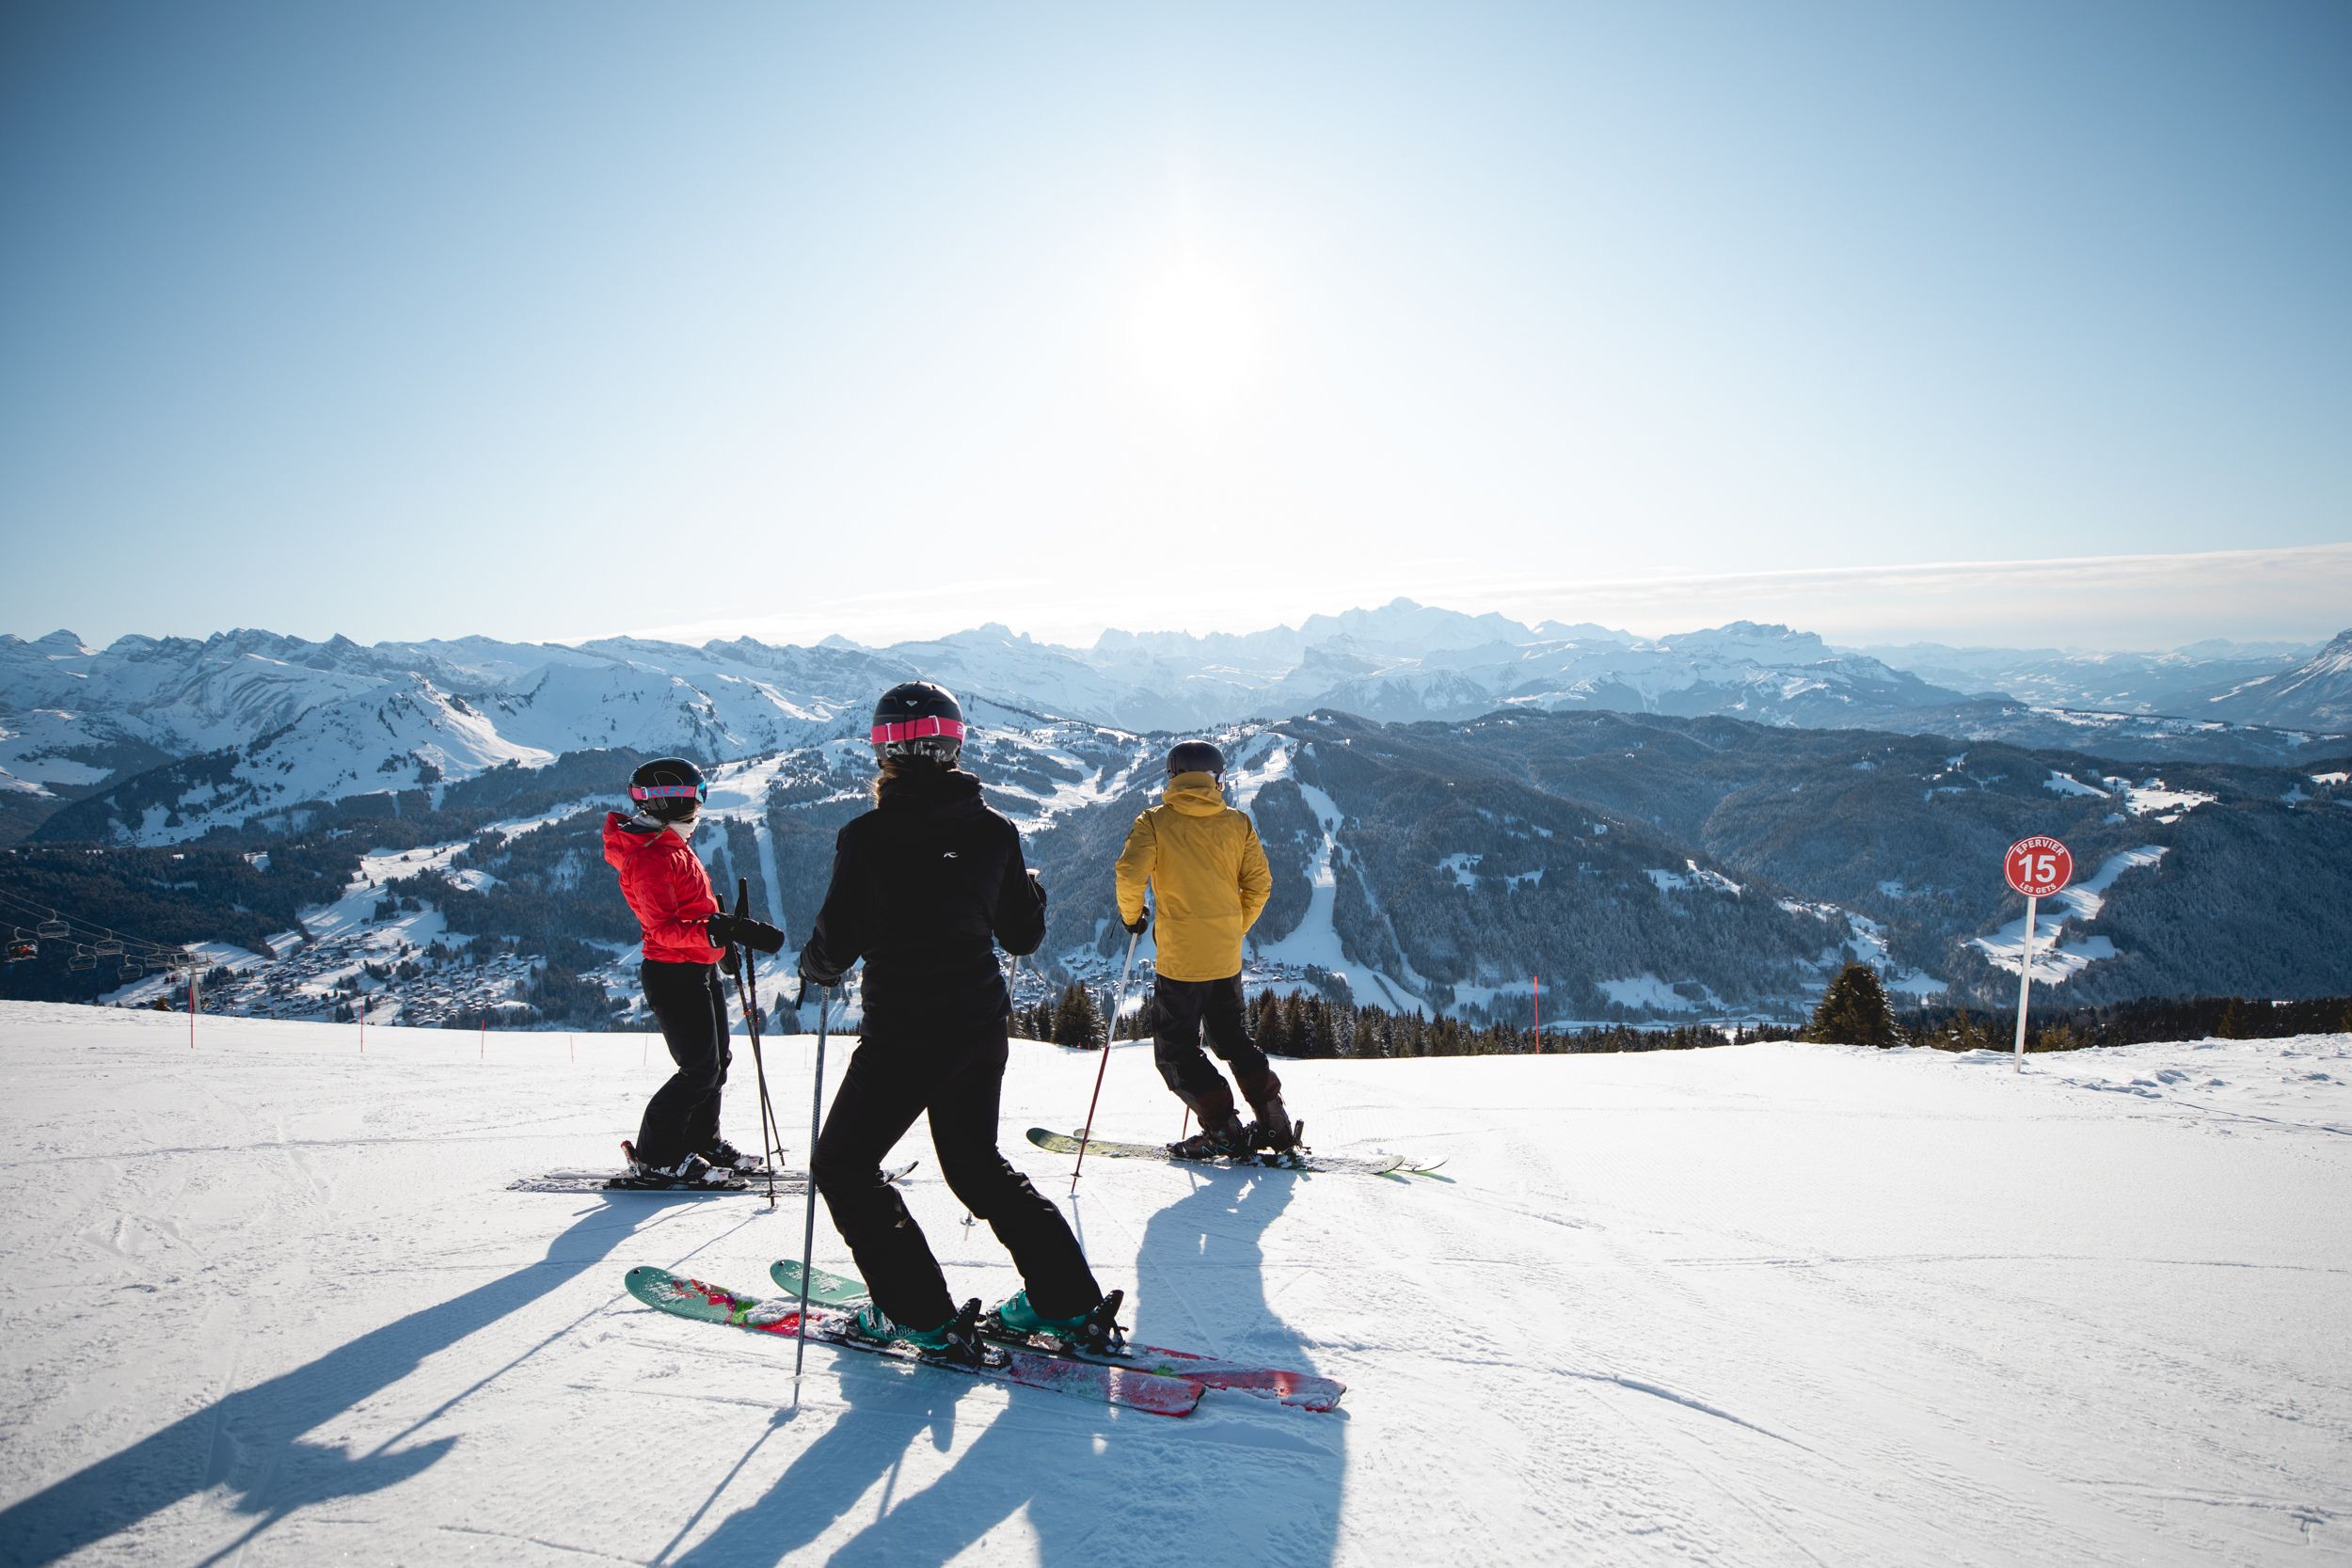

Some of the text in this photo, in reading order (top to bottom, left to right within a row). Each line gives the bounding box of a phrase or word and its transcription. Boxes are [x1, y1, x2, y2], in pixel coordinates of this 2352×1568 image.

[646, 786, 689, 798] KLEY
[2015, 839, 2065, 856] EPERVIER
[2018, 854, 2057, 883] 15
[2019, 882, 2057, 894] LES GETS
